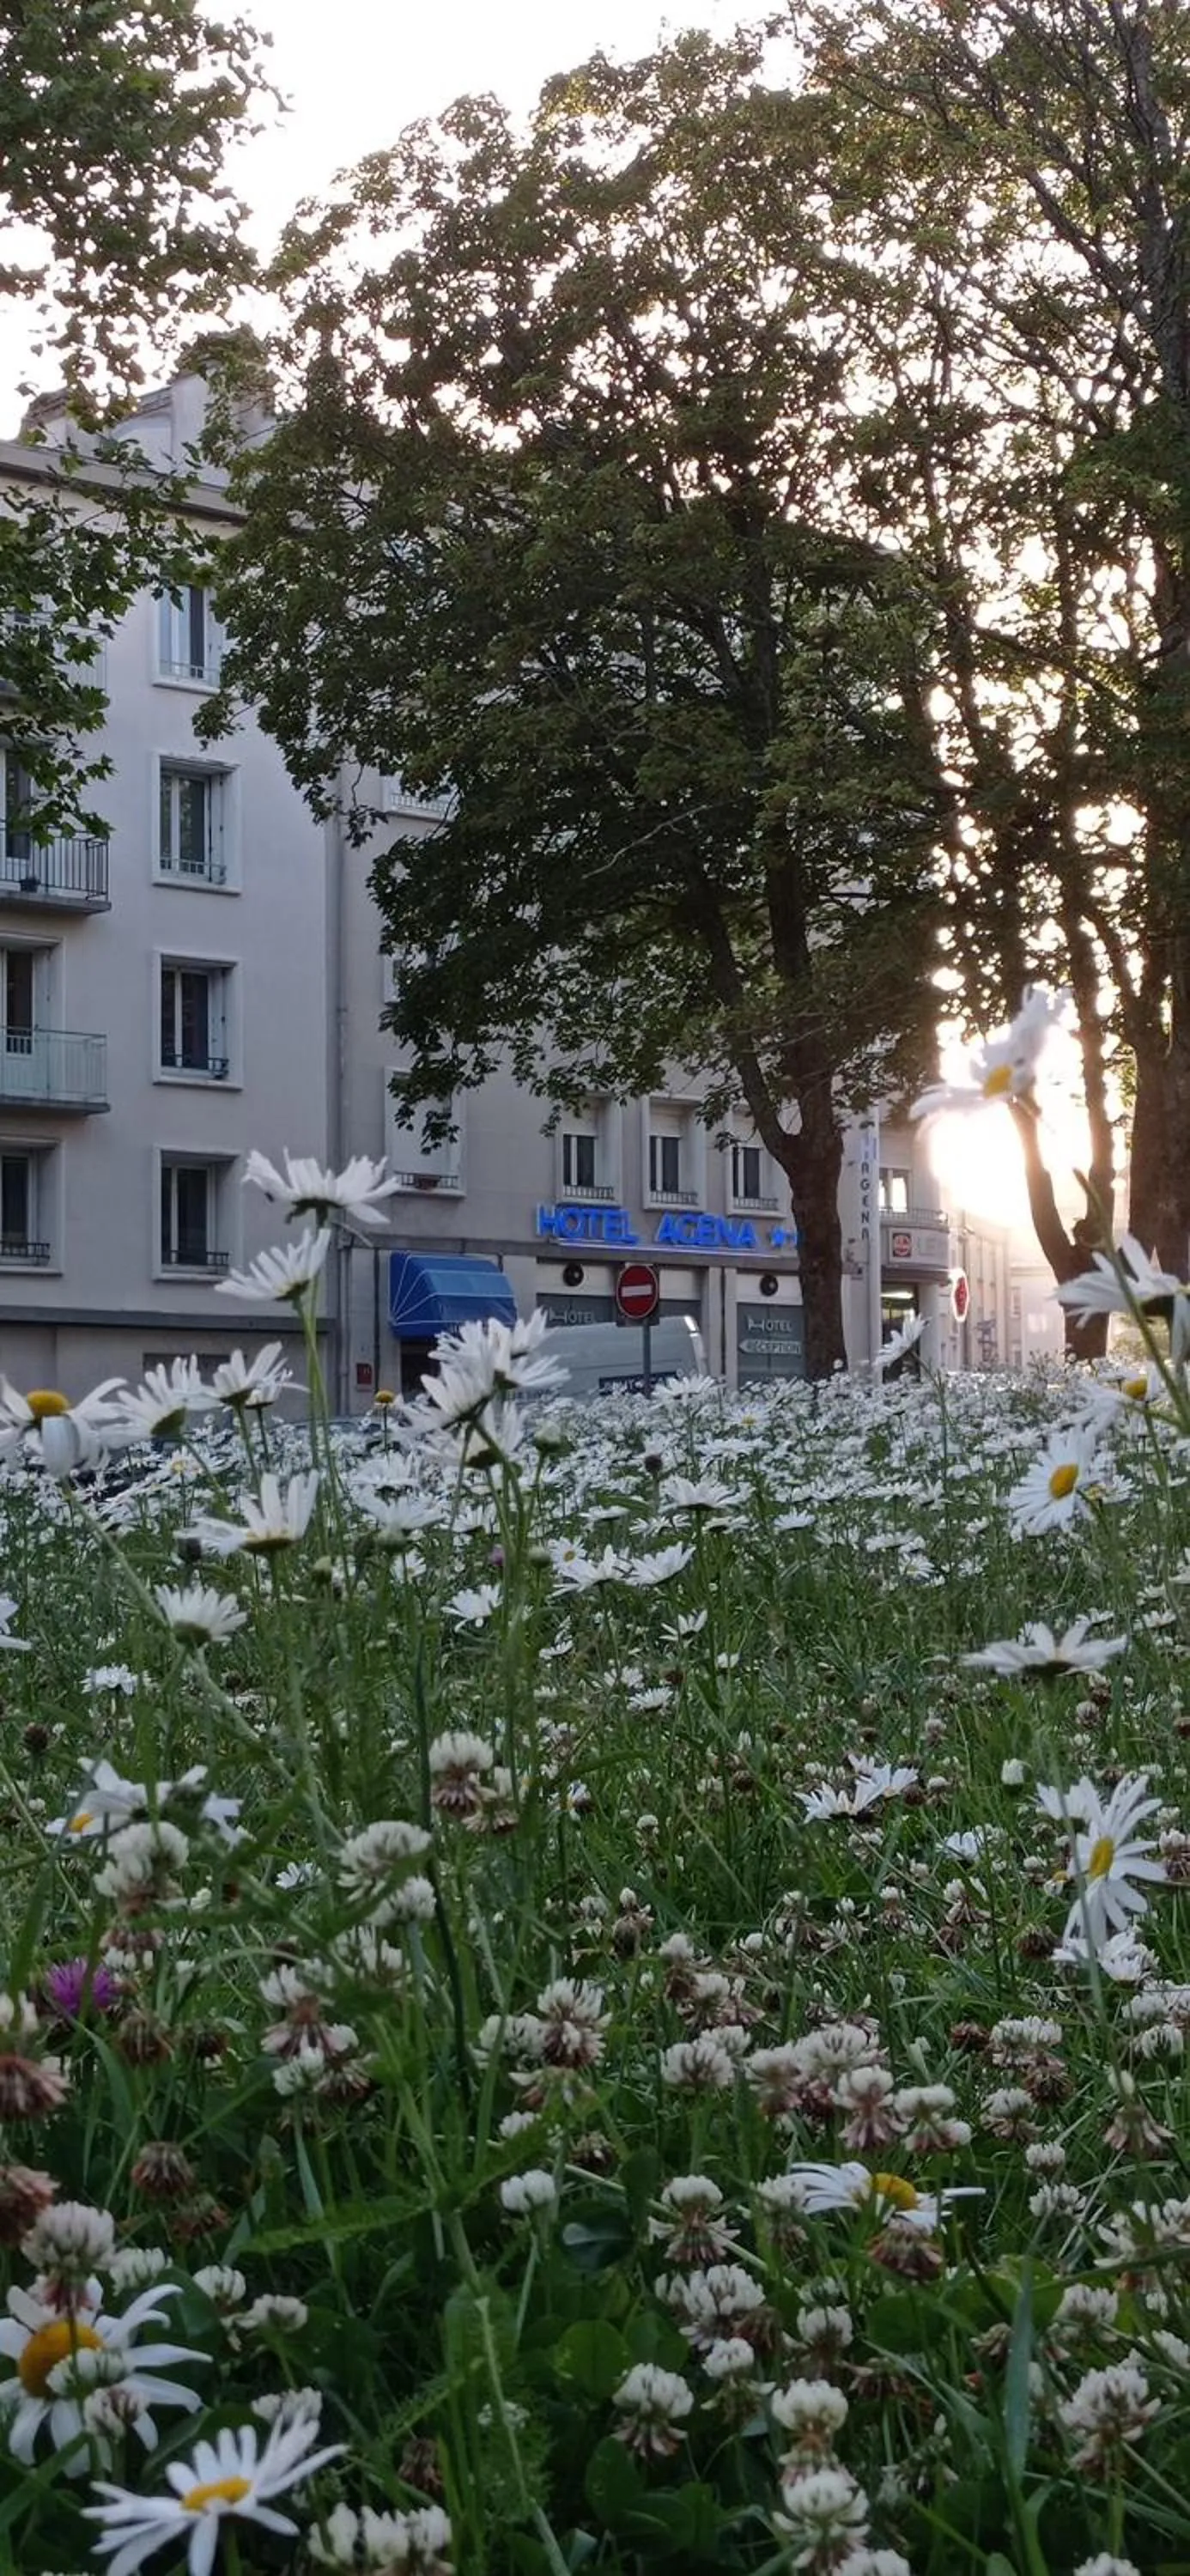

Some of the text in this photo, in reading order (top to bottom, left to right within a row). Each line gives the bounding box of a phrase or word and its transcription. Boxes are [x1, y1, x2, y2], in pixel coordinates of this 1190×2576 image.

[537, 1204, 756, 1248] HOTEL AGENA
[748, 1315, 792, 1332] HOTEL
